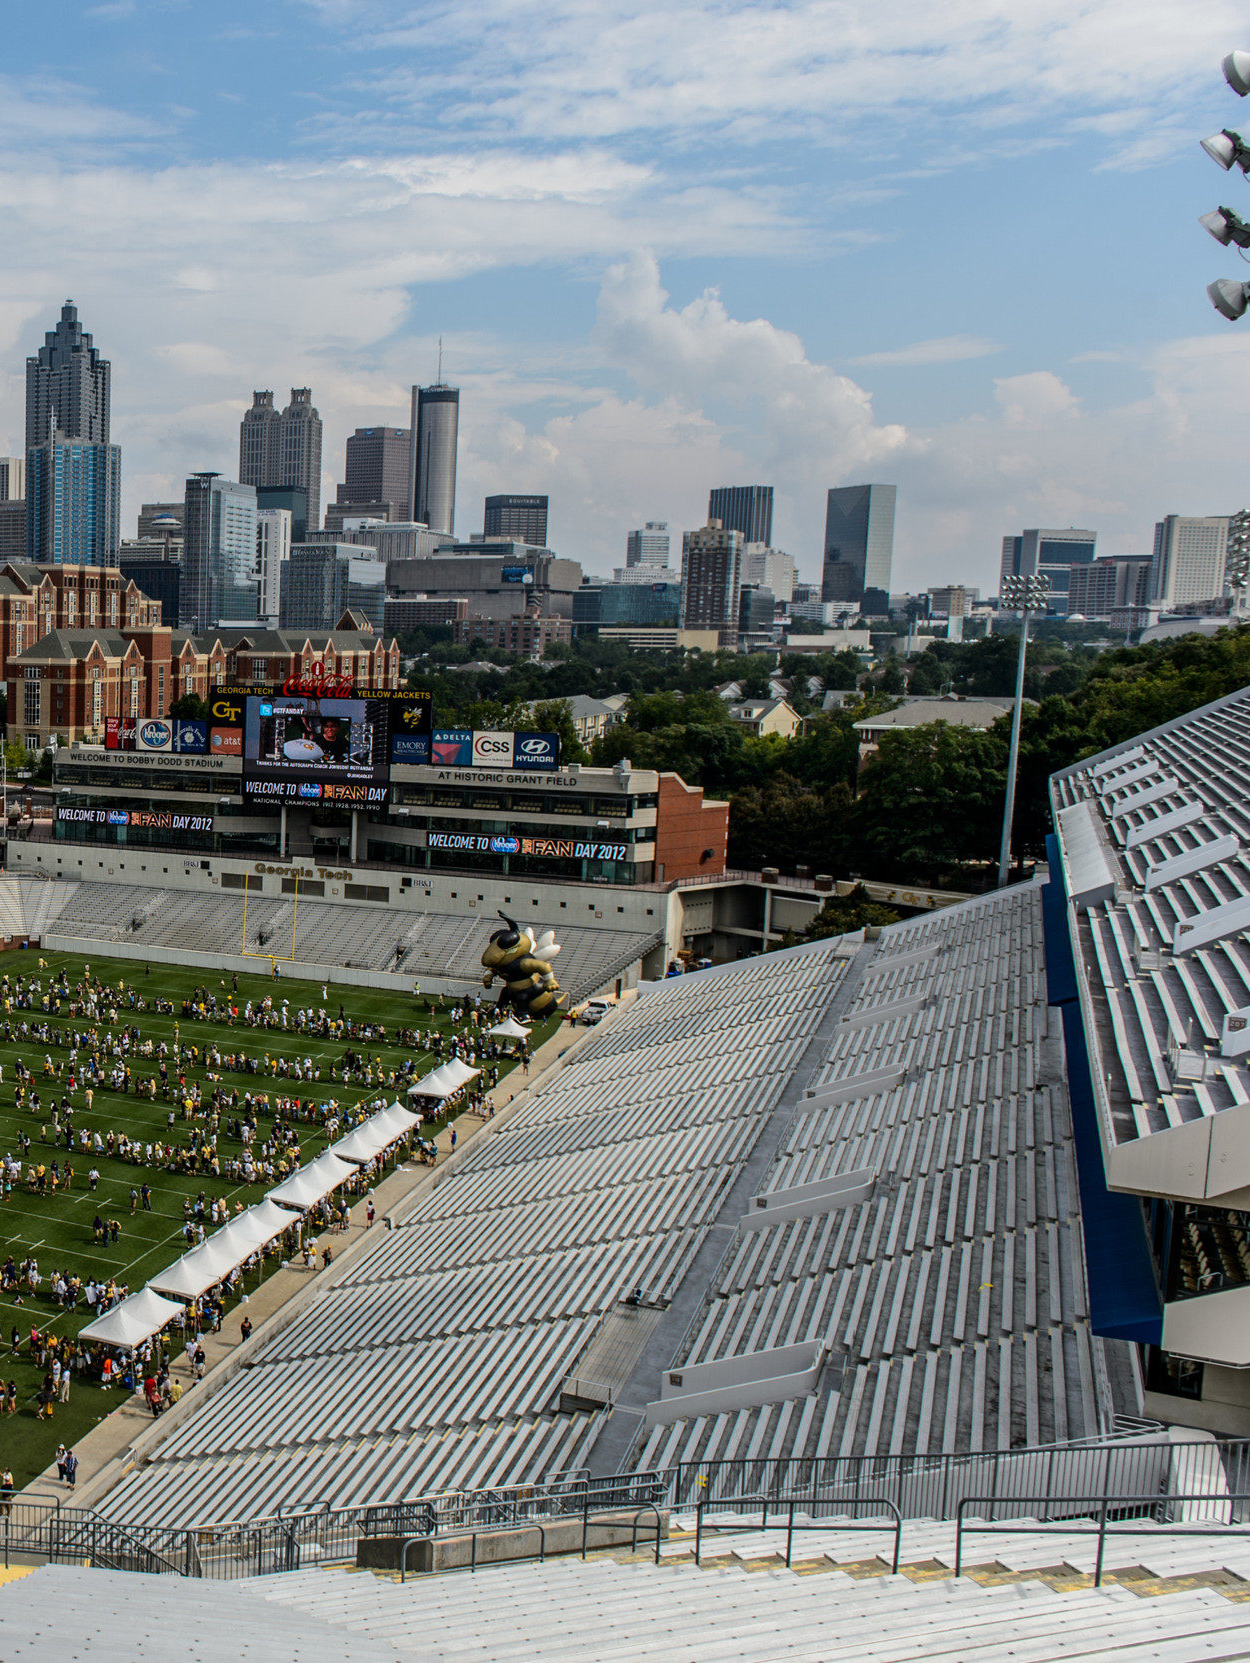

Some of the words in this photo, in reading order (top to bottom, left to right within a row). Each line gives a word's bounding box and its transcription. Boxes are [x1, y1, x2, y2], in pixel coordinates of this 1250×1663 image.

[217, 686, 251, 695] GEORGIA
[253, 687, 273, 695] TECH
[357, 690, 391, 699] YELLOW
[393, 691, 431, 700] JACKETS
[144, 725, 169, 745] Kroger
[224, 736, 241, 746] at&t
[397, 741, 426, 750] EMORY
[480, 740, 510, 753] CSS
[70, 753, 111, 763] WELCOME
[114, 755, 124, 763] TO
[127, 755, 155, 765] BOBBY
[158, 757, 182, 766] DODD
[184, 758, 223, 768] STADIUM
[516, 755, 554, 763] HYUNDAI
[438, 772, 451, 780] AT
[454, 773, 503, 783] HISTORIC
[506, 775, 543, 785] GRANT
[547, 777, 577, 786] FIELD
[245, 781, 285, 795] WELCOME
[286, 784, 297, 795] TO
[332, 784, 368, 800] FAN
[368, 787, 388, 801] DAY
[284, 799, 320, 807] CHAMPIONS
[58, 808, 95, 822] WELCOME
[96, 810, 106, 822] TO
[140, 812, 172, 828] FAN
[172, 816, 190, 829] DAY
[190, 817, 213, 831] 2012
[428, 834, 474, 849] WELCOME
[476, 837, 489, 850] TO
[493, 836, 518, 852] Kroger
[532, 839, 574, 857] FAN
[574, 843, 598, 858] DAY
[598, 845, 626, 860] 2012
[254, 863, 314, 879] Georgia
[317, 868, 353, 881] Tech
[413, 879, 432, 888] BB&T
